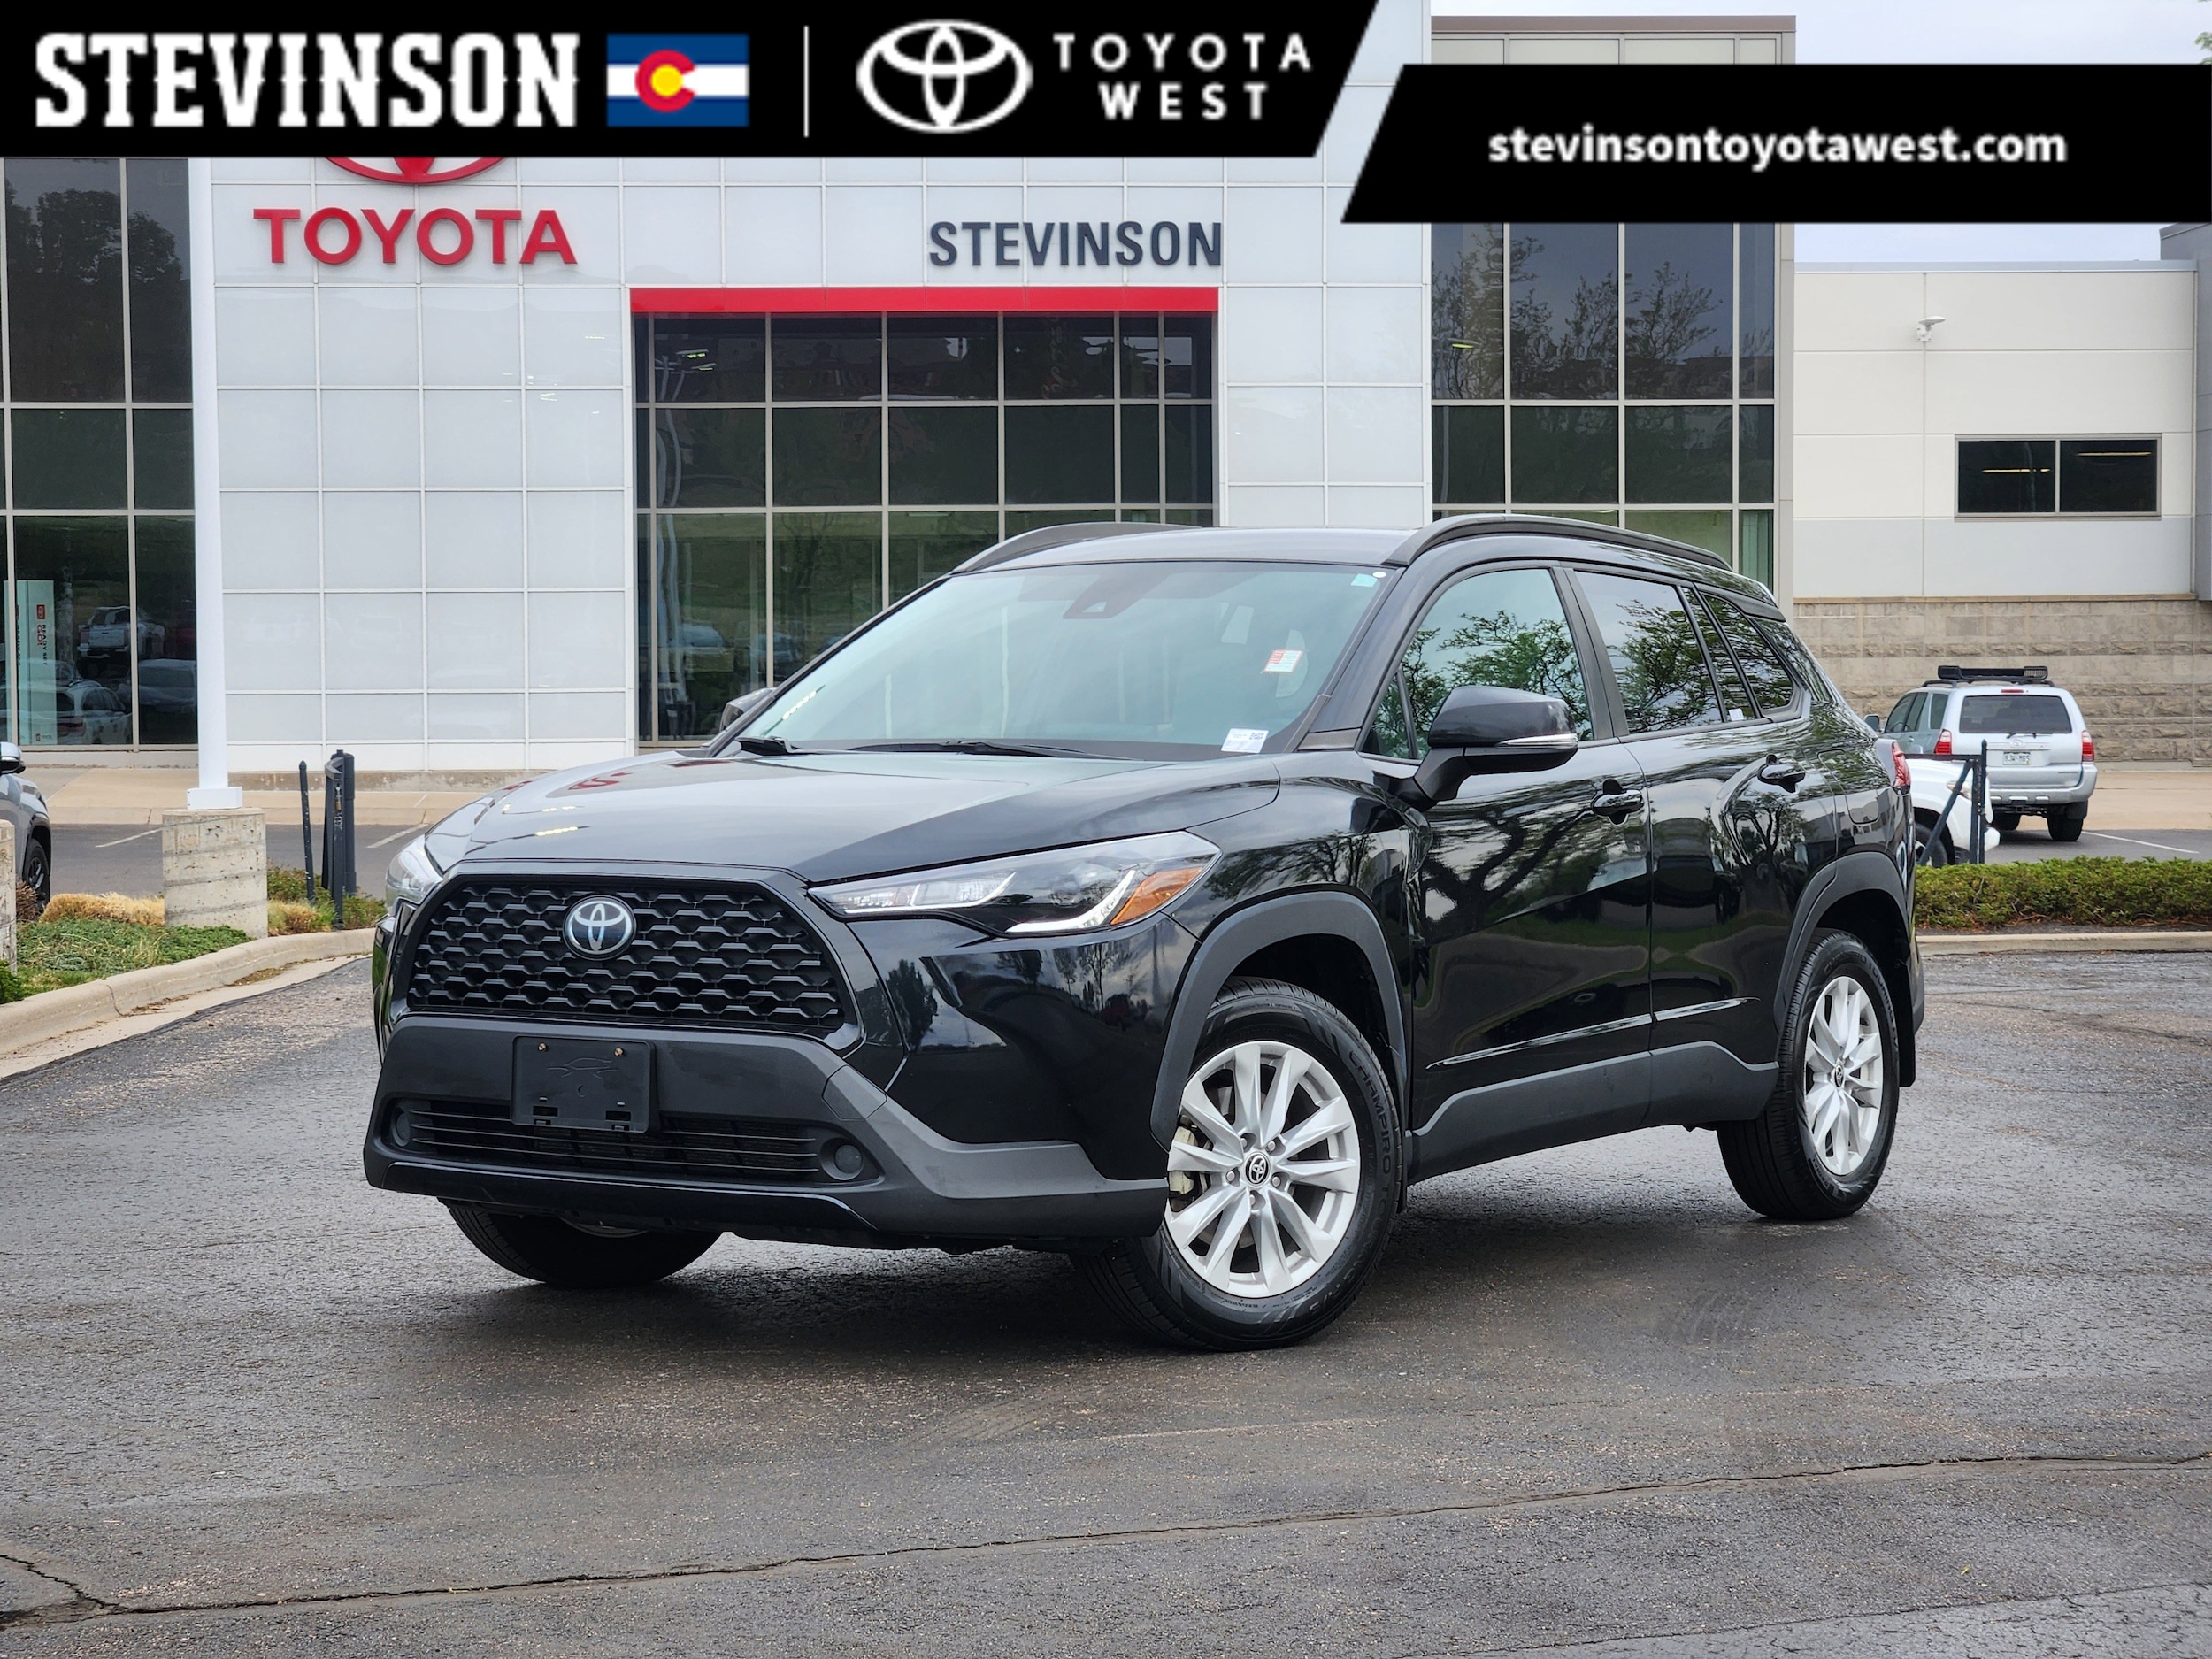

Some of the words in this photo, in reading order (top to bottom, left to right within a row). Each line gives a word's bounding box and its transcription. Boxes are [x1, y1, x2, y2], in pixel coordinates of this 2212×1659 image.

[253, 208, 578, 265] TOYOTA
[929, 221, 1222, 267] STEVINSON
[1348, 1050, 1392, 1175] CHAMPIRO
